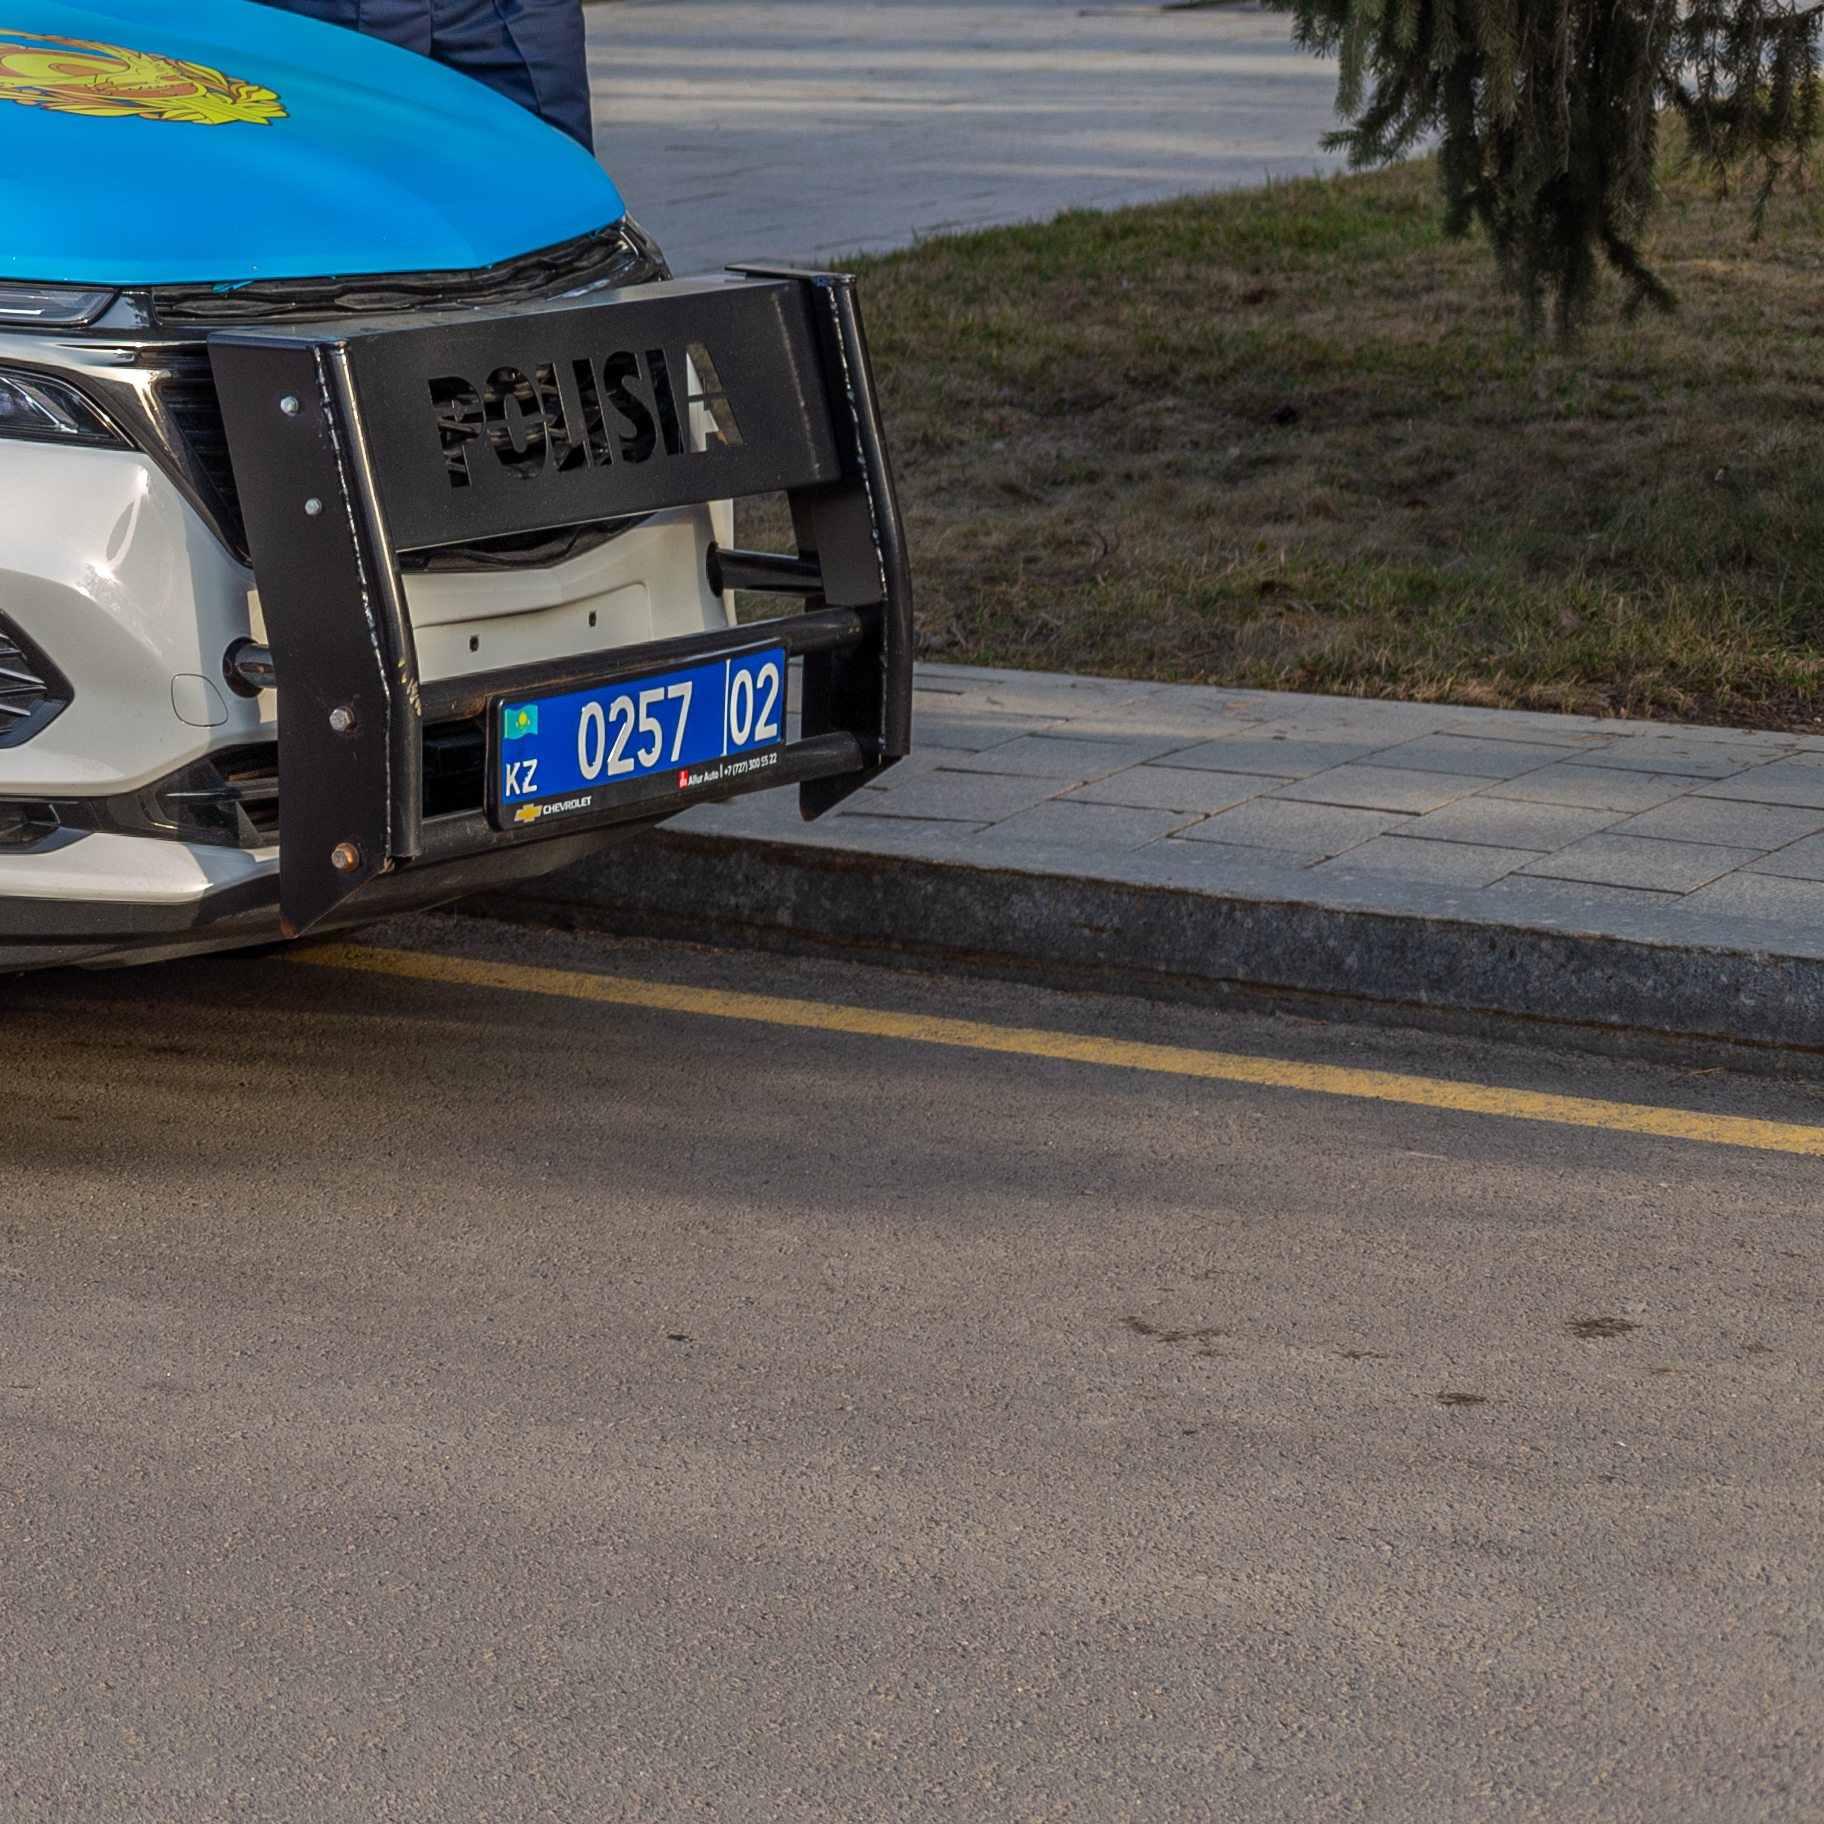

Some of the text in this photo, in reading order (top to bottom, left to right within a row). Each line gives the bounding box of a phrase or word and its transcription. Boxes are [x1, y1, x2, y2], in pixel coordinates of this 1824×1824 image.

[427, 342, 745, 488] POLISIA
[577, 662, 780, 780] 0257 02
[505, 758, 538, 797] KZ
[704, 771, 719, 782] Auto
[542, 796, 592, 815] CHEVROLET
